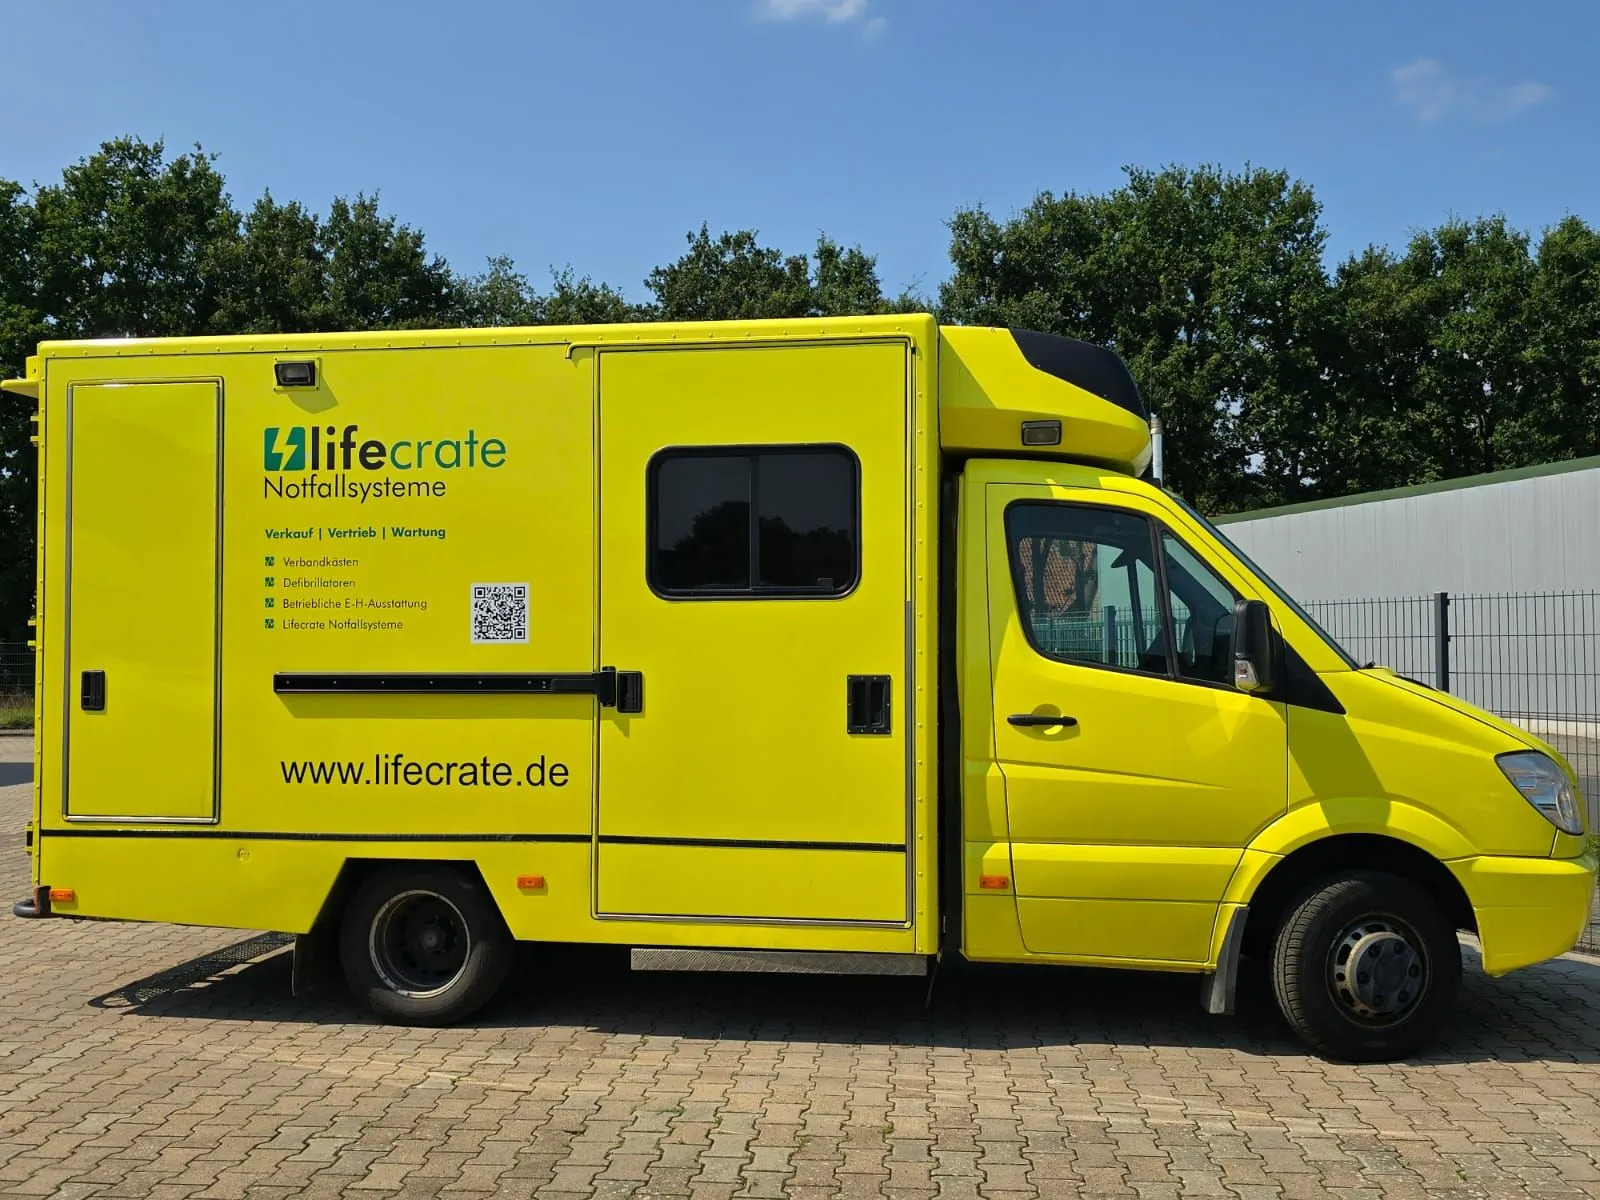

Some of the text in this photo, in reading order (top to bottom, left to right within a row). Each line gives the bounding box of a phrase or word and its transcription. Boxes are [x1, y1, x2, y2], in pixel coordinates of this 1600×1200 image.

[311, 424, 507, 470] lifecrate
[264, 473, 446, 504] Notfallsysteme
[265, 527, 314, 540] Verkauf
[327, 526, 377, 539] Vertrieb
[391, 526, 446, 540] Wartung
[283, 556, 359, 567] Verbandkästen
[283, 577, 356, 589] Defibrillatoren
[283, 598, 428, 611] Betriebliche E-H-Ausstattung
[282, 618, 403, 632] Lifecrate Notfallsysteme
[280, 752, 569, 788] www.lifecrate.de
